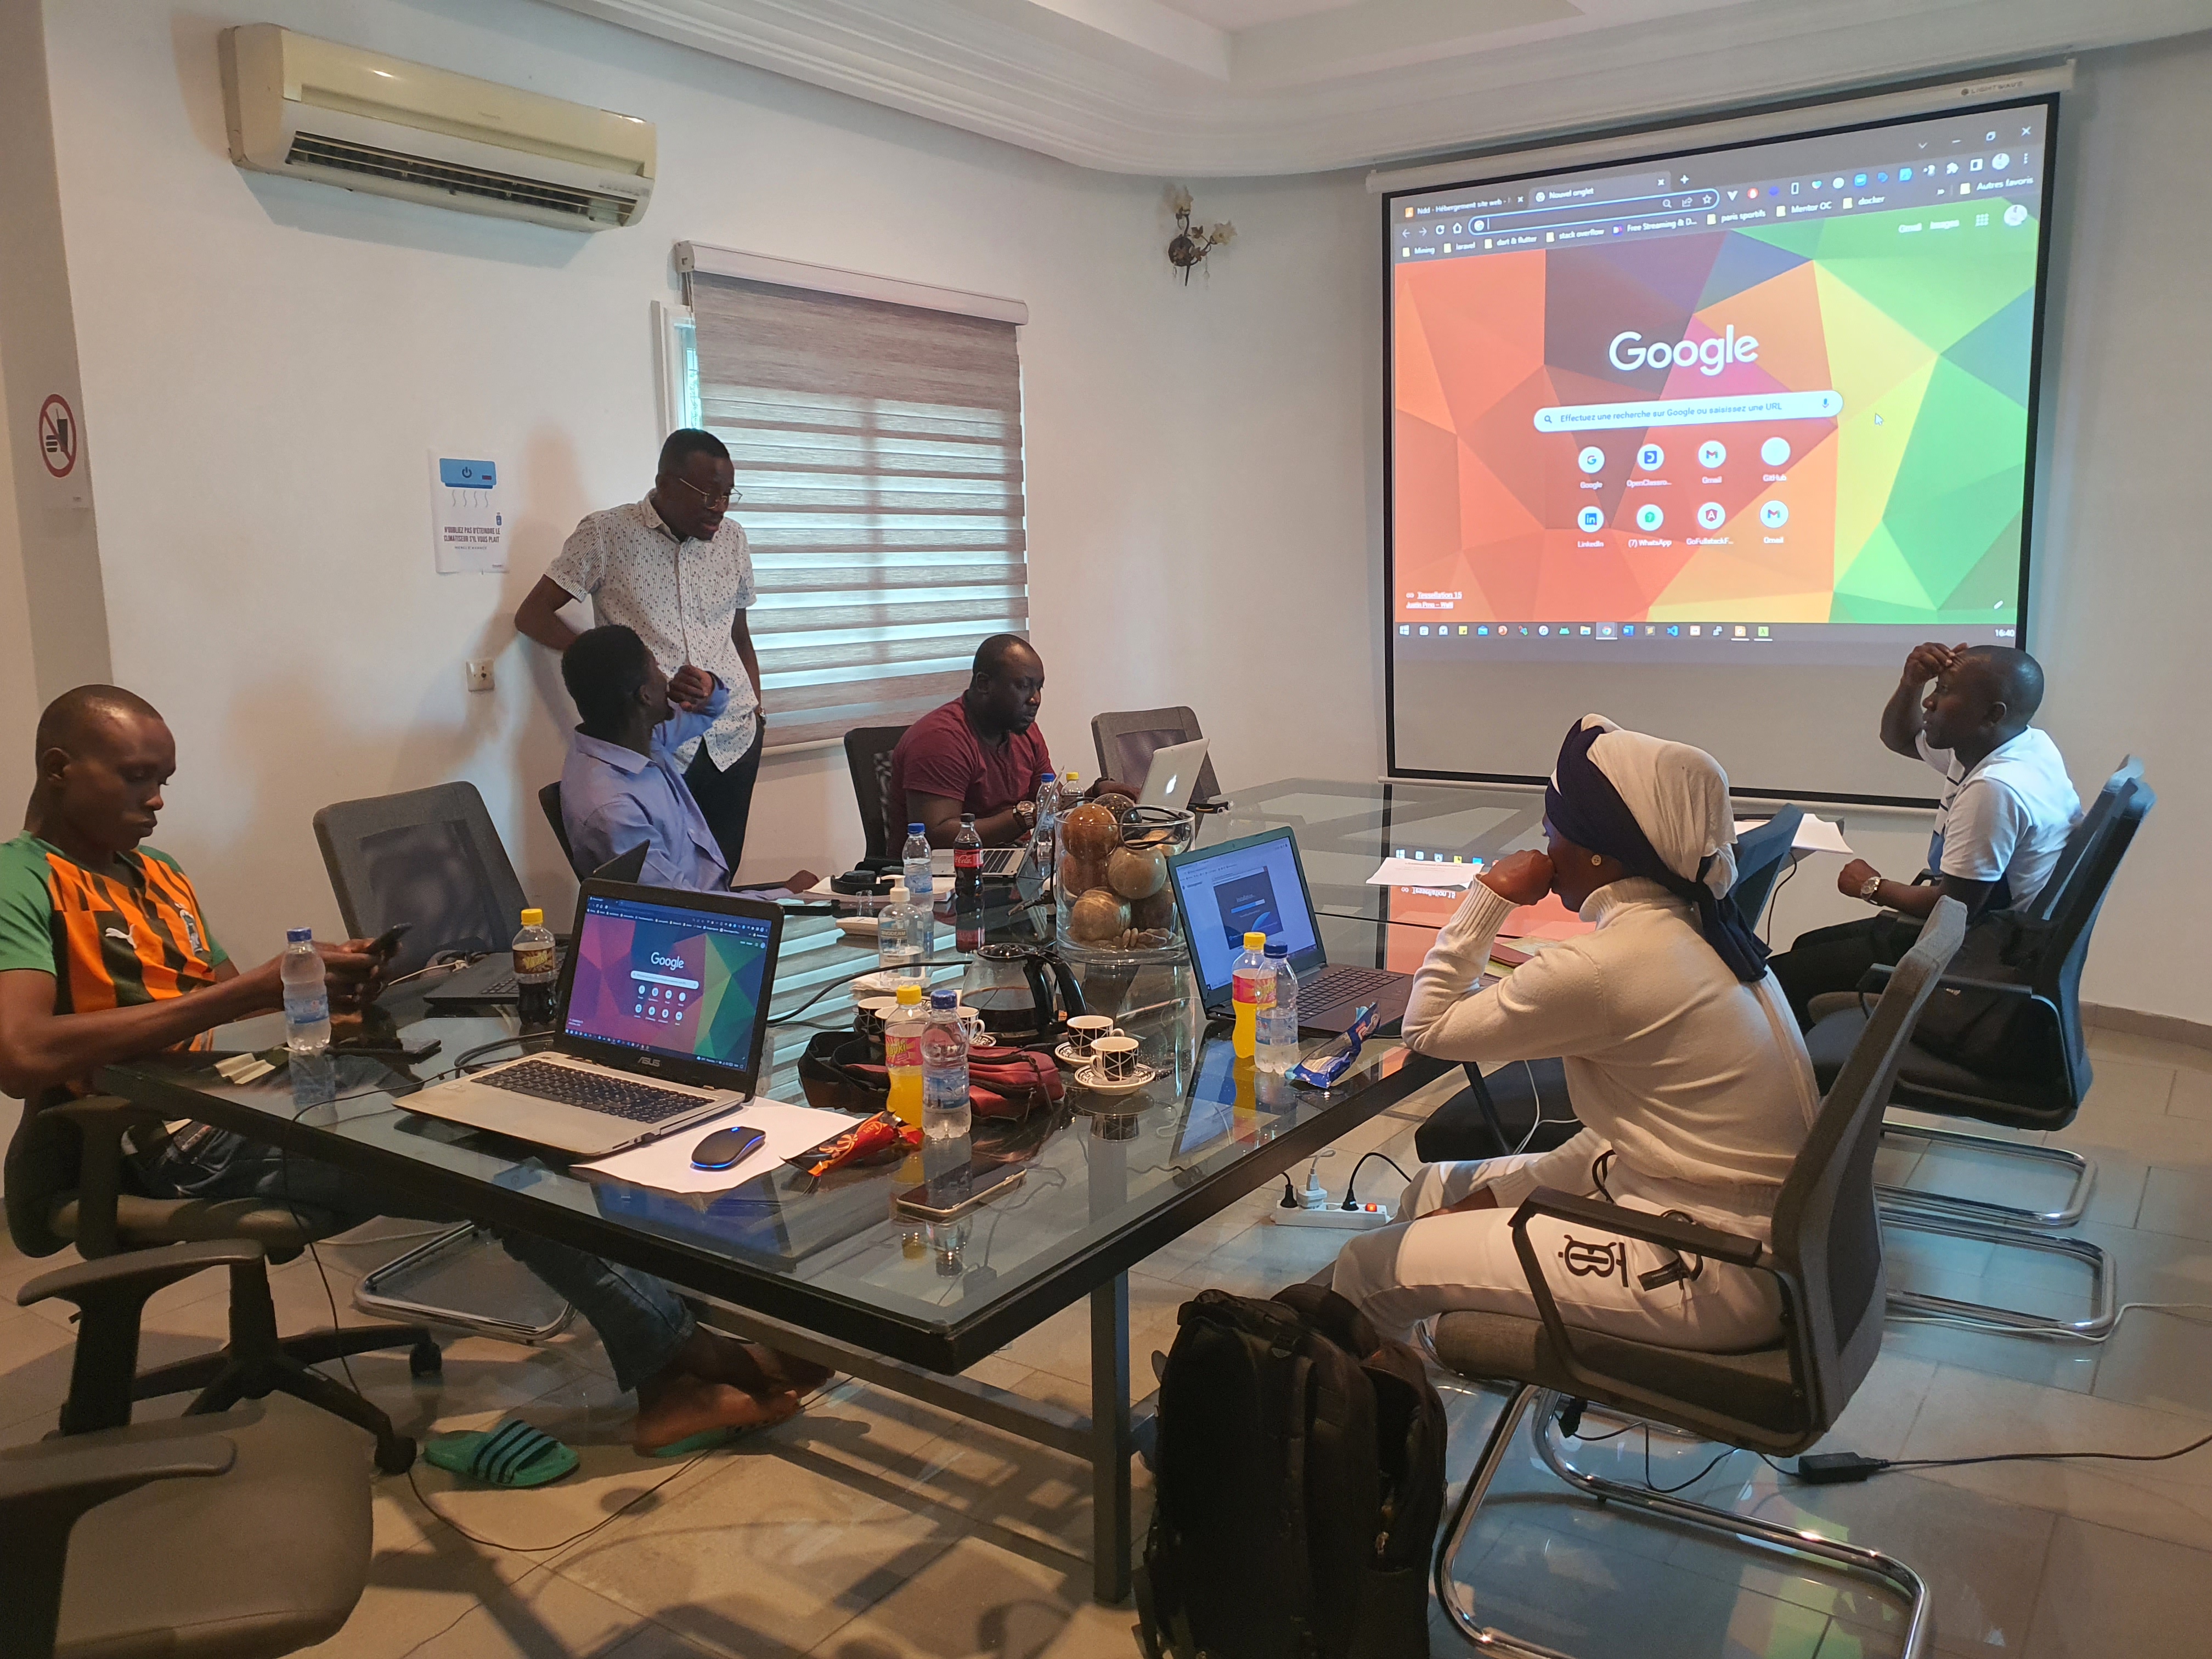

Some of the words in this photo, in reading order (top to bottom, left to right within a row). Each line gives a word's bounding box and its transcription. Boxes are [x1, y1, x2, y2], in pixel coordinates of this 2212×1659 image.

[1976, 180, 2004, 191] Autres
[2006, 175, 2034, 188] favoris
[1549, 190, 1572, 200] Nouvel
[1572, 188, 1594, 197] onglet
[1489, 198, 1503, 207] web
[1858, 195, 1885, 206] docker
[1791, 203, 1819, 214] Mentor
[1820, 200, 1832, 210] OC
[1721, 214, 1739, 224] paris
[1627, 224, 1642, 233] Free
[1643, 219, 1677, 230] Streaming
[1677, 218, 1684, 227] &
[1576, 229, 1605, 237] overflow
[1497, 238, 1510, 246] dart
[1609, 324, 1759, 376] Google
[1560, 413, 1596, 423] Effectuez
[1613, 410, 1651, 420] recherche
[1667, 408, 1695, 418] Google
[1709, 405, 1747, 414] saisissez
[1765, 402, 1782, 410] URL
[1763, 474, 1787, 483] GitHub
[1579, 481, 1603, 490] Google
[1577, 540, 1605, 548] LinkedIn
[1628, 539, 1638, 548] (7)
[1639, 539, 1673, 548] WhatsApp
[1417, 591, 1453, 599] Tessellation
[1454, 591, 1463, 599] 15
[1994, 627, 2016, 638] 16:40
[651, 952, 685, 971] Google
[637, 1056, 661, 1067] ASUS
